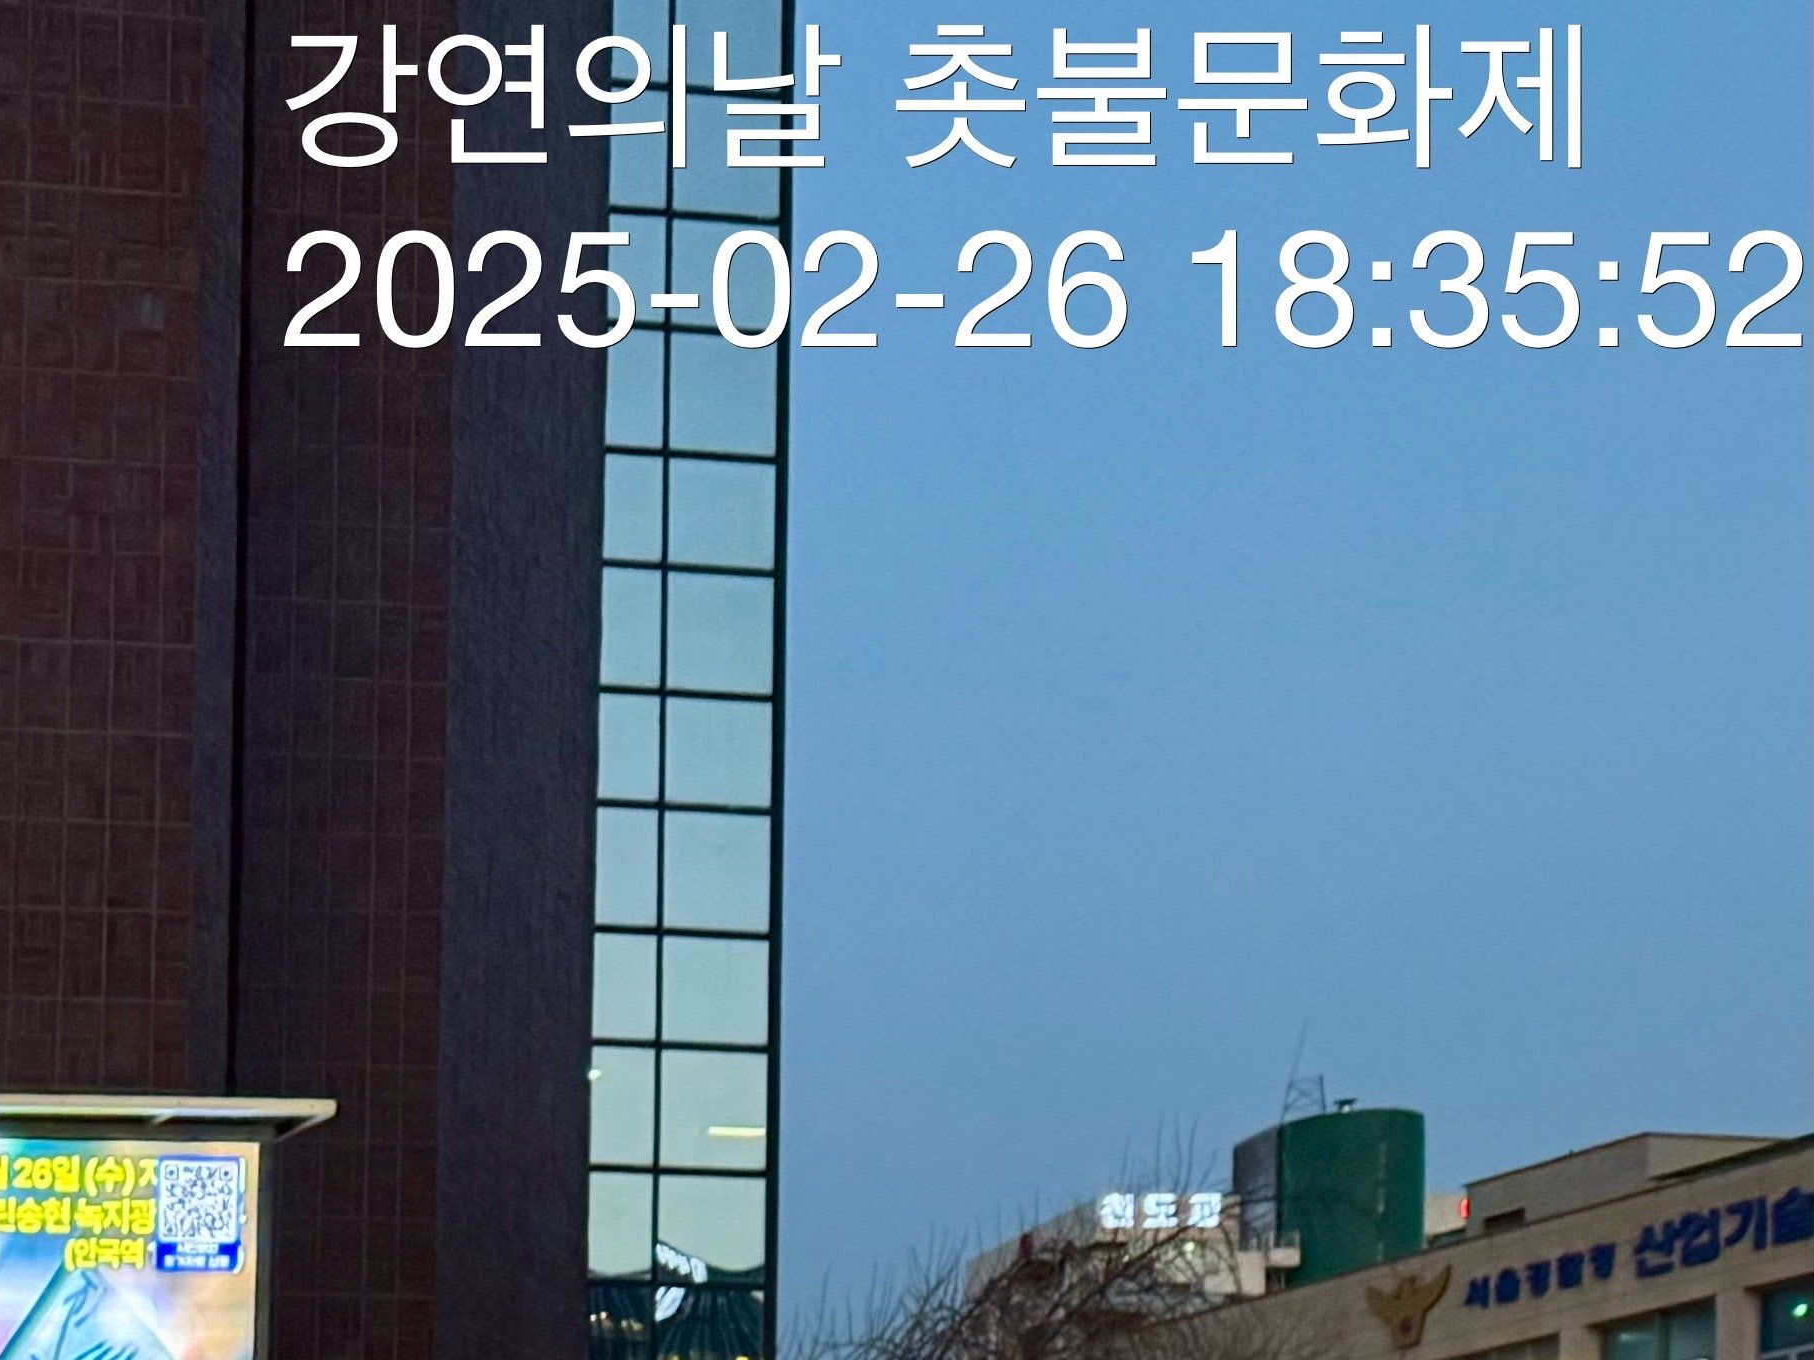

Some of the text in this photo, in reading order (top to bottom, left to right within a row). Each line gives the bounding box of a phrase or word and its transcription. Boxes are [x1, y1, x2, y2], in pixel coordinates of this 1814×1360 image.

[13, 1155, 80, 1193] 26일
[85, 1157, 135, 1196] (수)
[73, 1197, 156, 1234] 녹지광
[1632, 1186, 1814, 1279] 산업기술
[65, 1237, 146, 1271] (안국역
